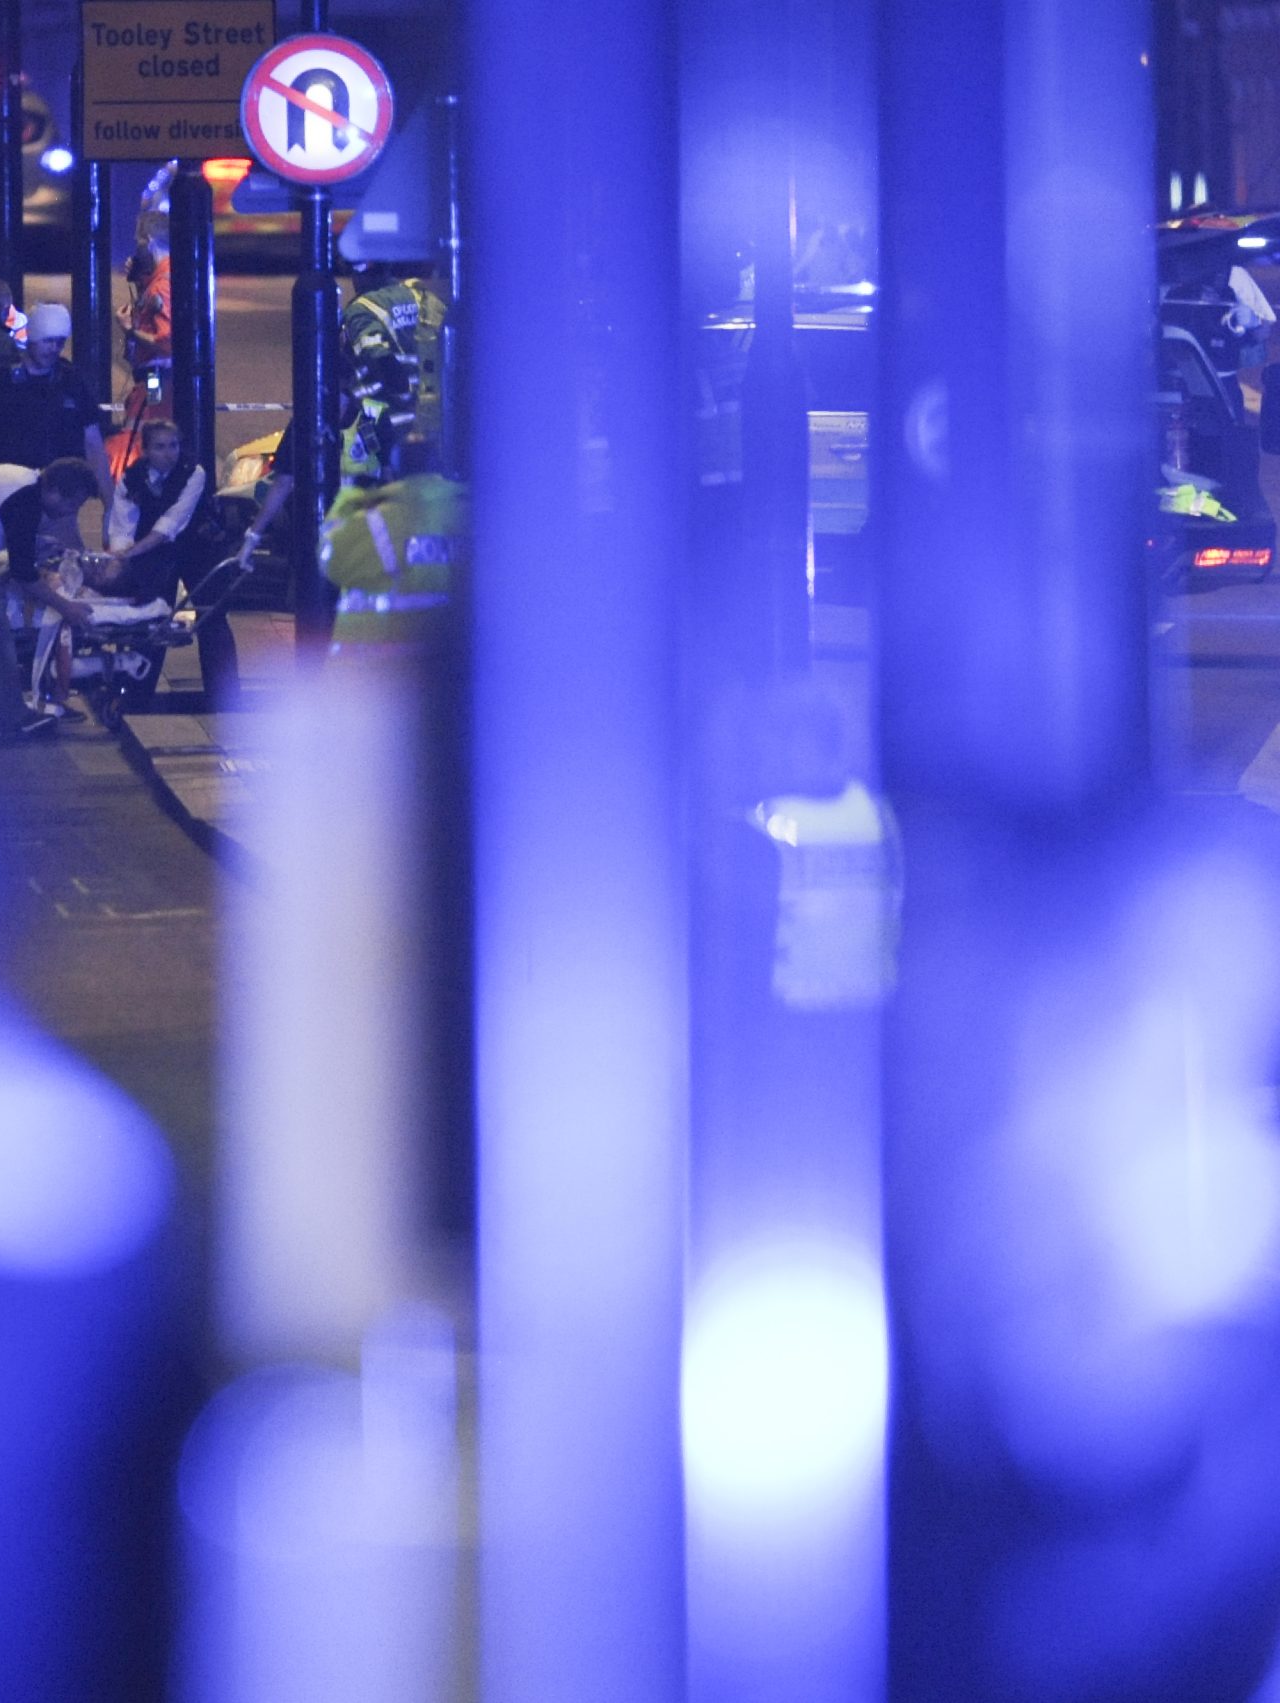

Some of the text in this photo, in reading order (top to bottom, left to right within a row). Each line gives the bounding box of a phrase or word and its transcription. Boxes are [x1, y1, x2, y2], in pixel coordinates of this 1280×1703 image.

[91, 22, 265, 50] Tooley Street
[138, 54, 220, 78] closed
[94, 119, 244, 140] follow diversi
